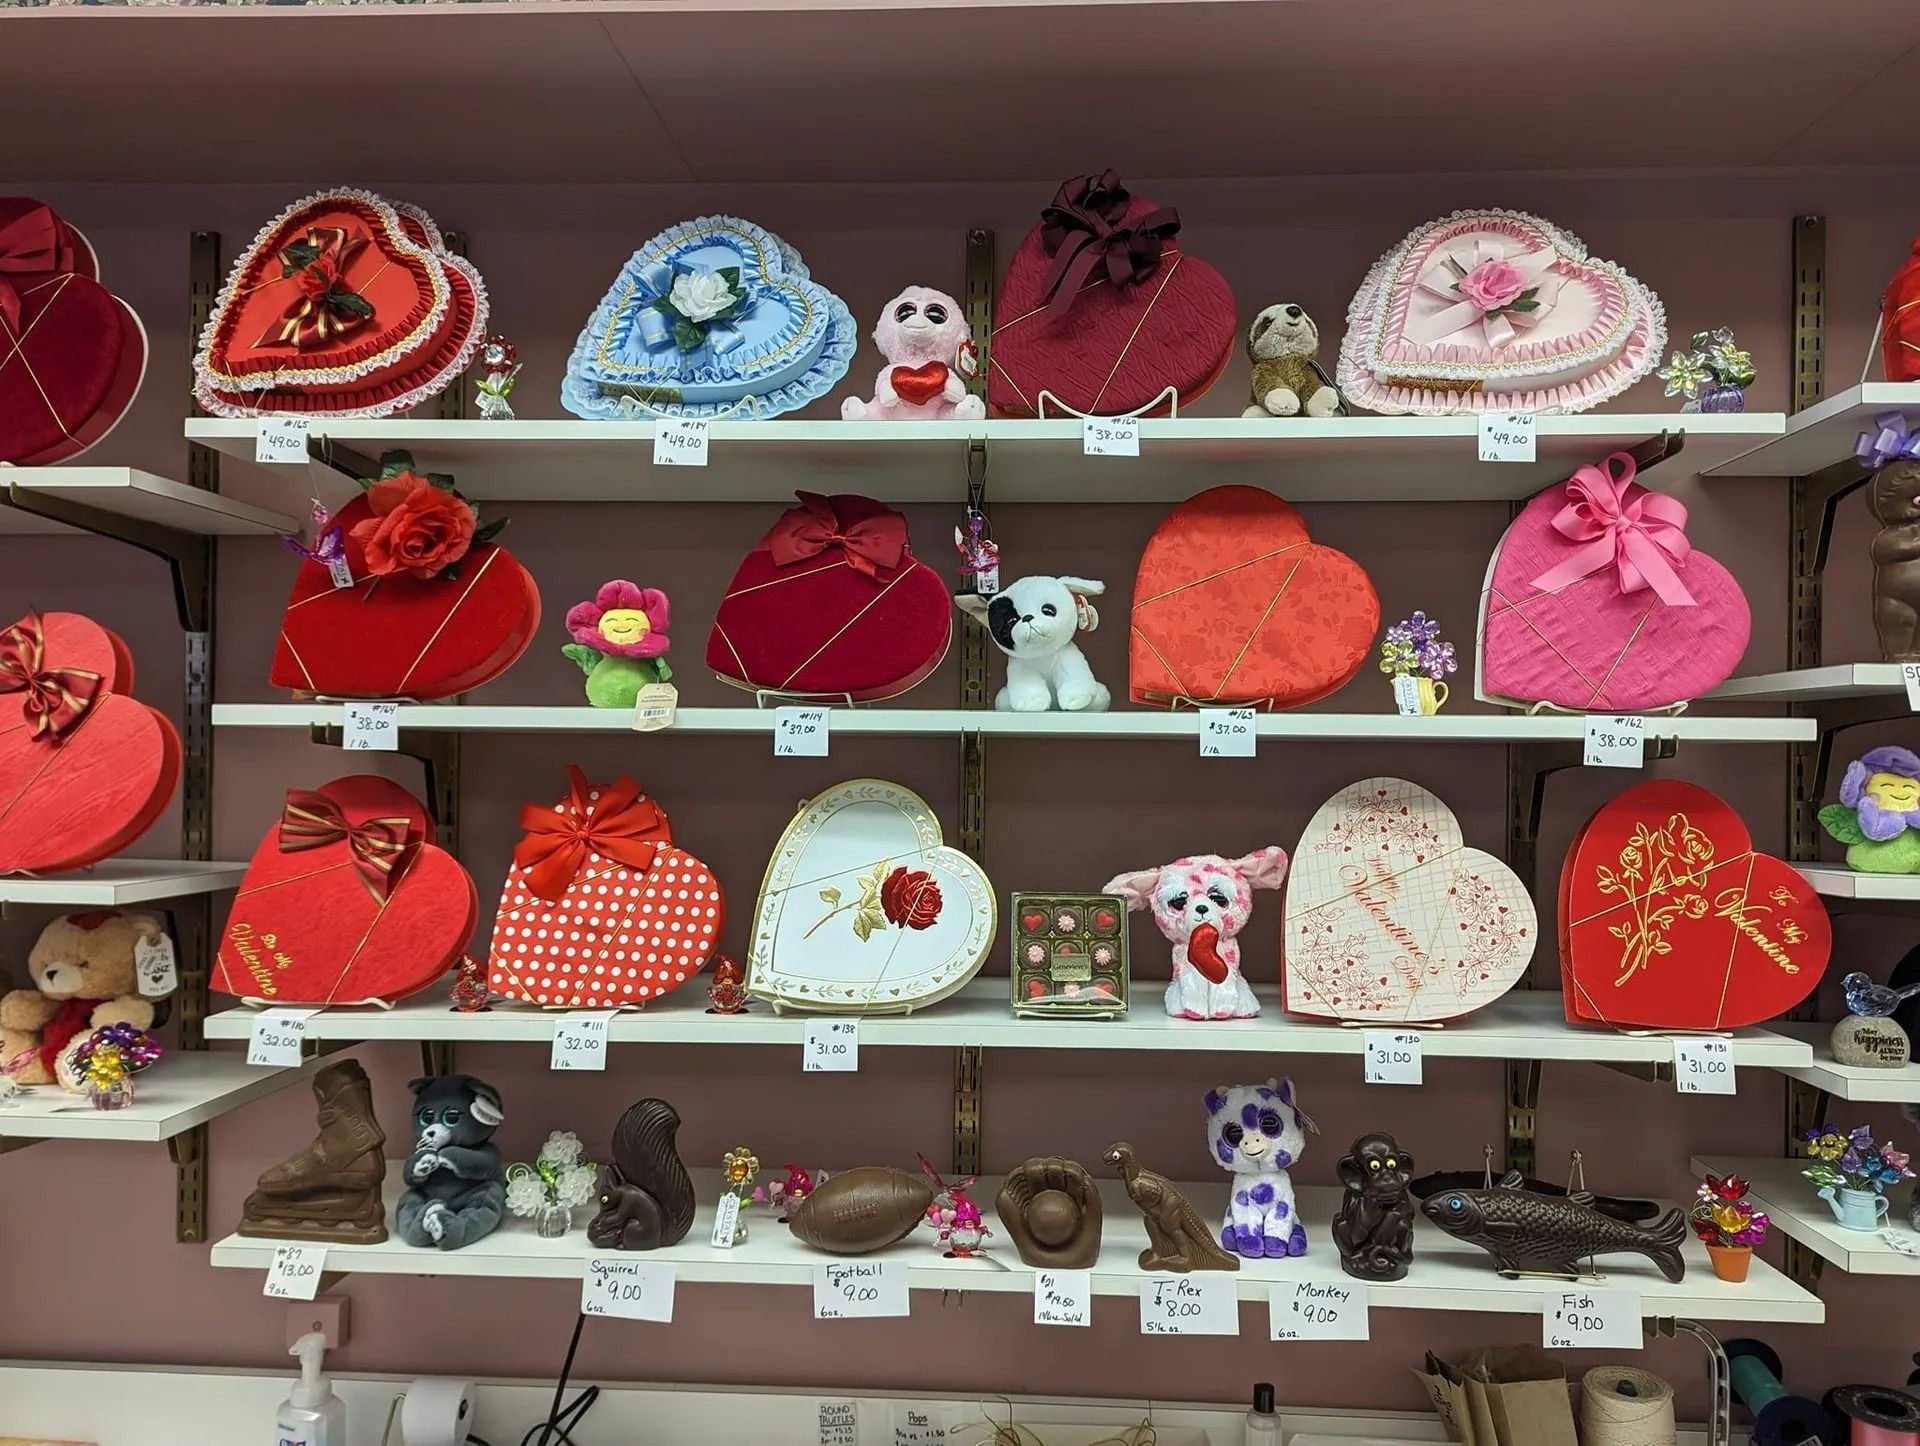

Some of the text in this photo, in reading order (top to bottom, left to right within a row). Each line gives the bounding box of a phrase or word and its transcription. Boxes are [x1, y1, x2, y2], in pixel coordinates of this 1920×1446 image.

[284, 420, 309, 428] #165
[681, 420, 707, 430] #184
[1508, 415, 1533, 425] #161
[372, 704, 396, 714] #164
[799, 712, 823, 722] #114
[1228, 710, 1253, 720] #163
[1614, 717, 1643, 729] #162
[1714, 888, 1800, 975] Valentine
[228, 923, 278, 996] Valentine
[281, 1019, 304, 1030] #110
[582, 1021, 603, 1030] #111
[1394, 1036, 1420, 1044] #130
[1854, 1030, 1904, 1053] happiness
[1704, 1043, 1726, 1053] #131
[279, 1261, 314, 1276] $13.00
[590, 1260, 638, 1280] Squirrel
[827, 1263, 882, 1279] Football
[1296, 1282, 1350, 1303] Monkey
[1562, 1294, 1594, 1309] Fish
[820, 1405, 850, 1415] ROUND
[818, 1415, 855, 1425] TRUFFLES
[908, 1411, 928, 1424] Pops
